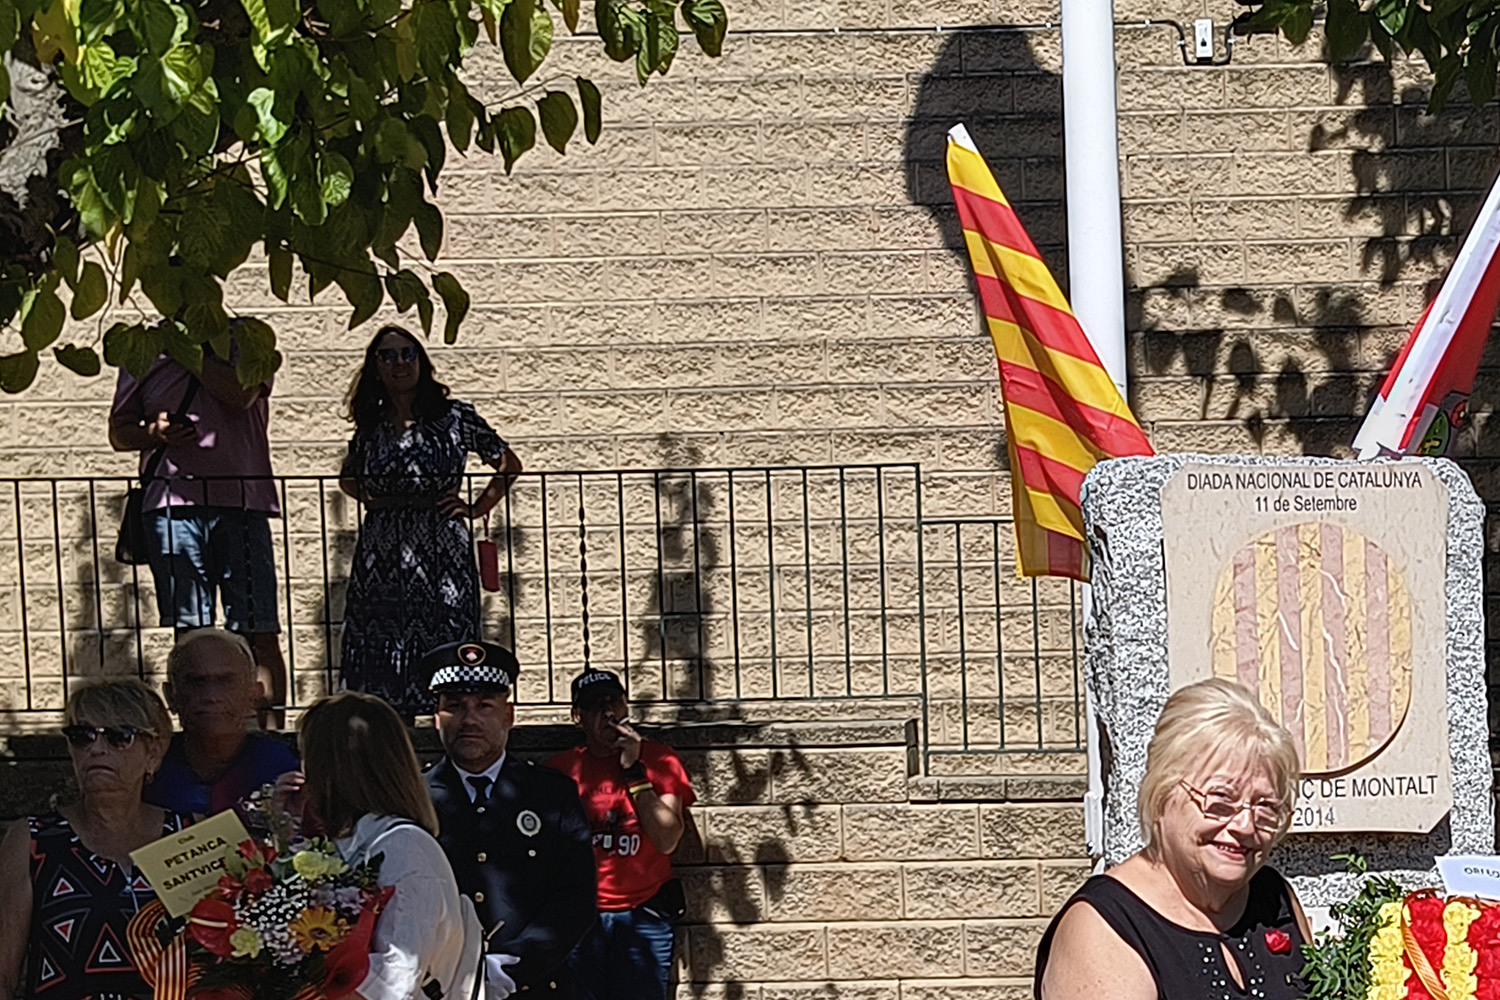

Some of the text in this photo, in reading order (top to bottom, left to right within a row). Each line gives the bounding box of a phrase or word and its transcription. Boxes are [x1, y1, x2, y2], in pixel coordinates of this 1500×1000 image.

[1187, 471, 1422, 490] DIADA NACIONAL DE CATALUNYA
[1254, 495, 1358, 512] 11 de Setembre
[1320, 778, 1347, 798] DE
[1351, 775, 1438, 797] MONTALT
[1292, 807, 1335, 826] 2014
[163, 836, 228, 869] PETANCA
